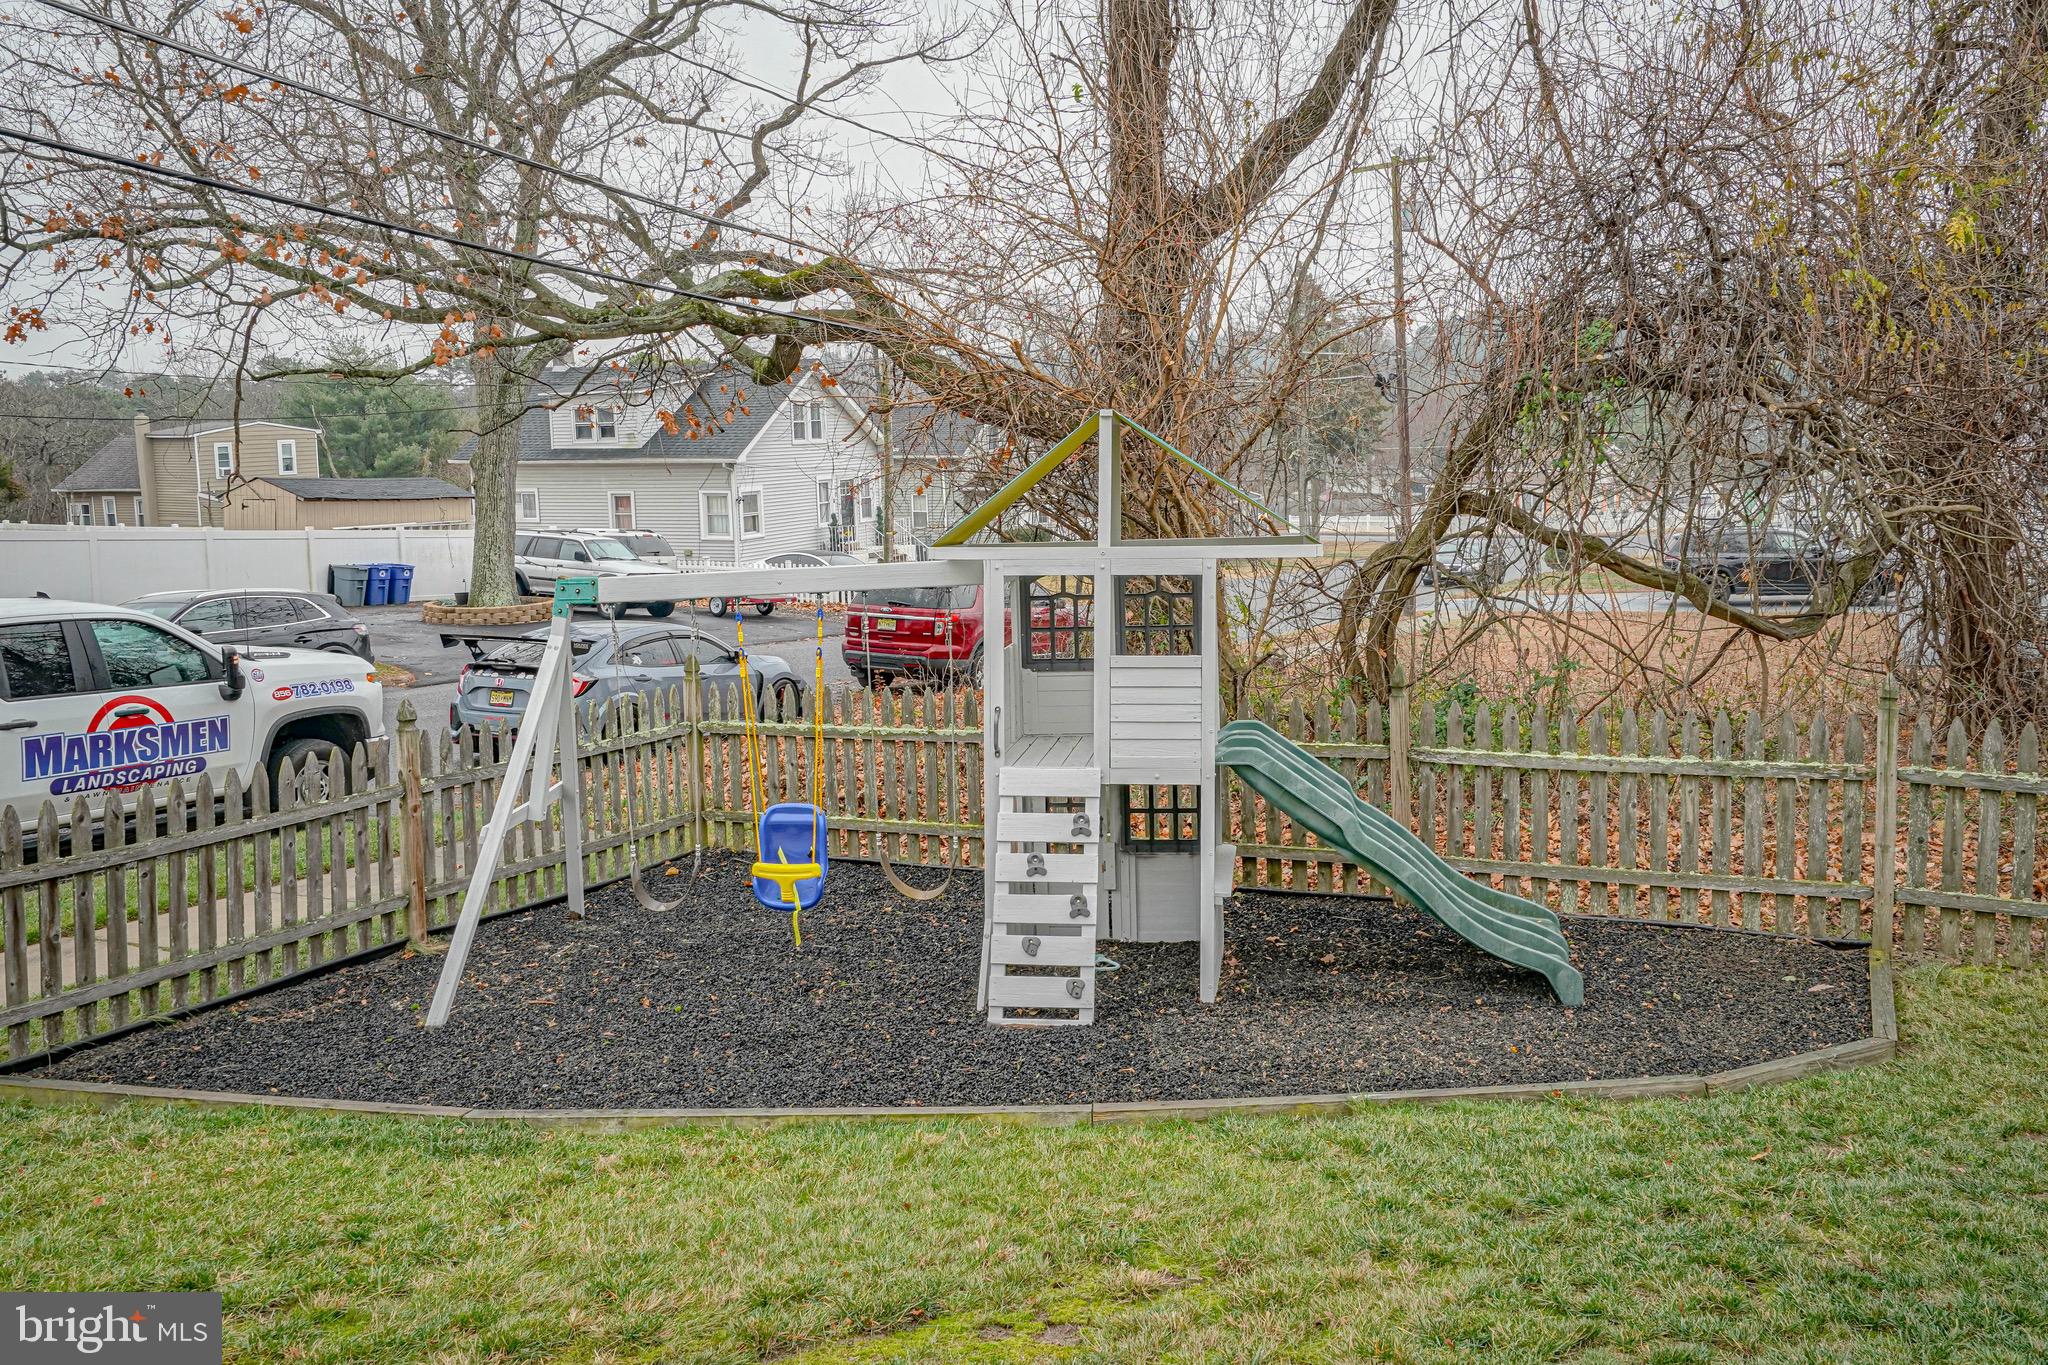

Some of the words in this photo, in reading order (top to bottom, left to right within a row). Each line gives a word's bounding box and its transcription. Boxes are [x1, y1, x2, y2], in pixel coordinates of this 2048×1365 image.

[274, 689, 292, 698] 856
[291, 679, 353, 697] 782-0198
[23, 716, 230, 780] MARKSMEN
[61, 759, 198, 793] LANDSCAPING
[84, 791, 109, 799] AWN
